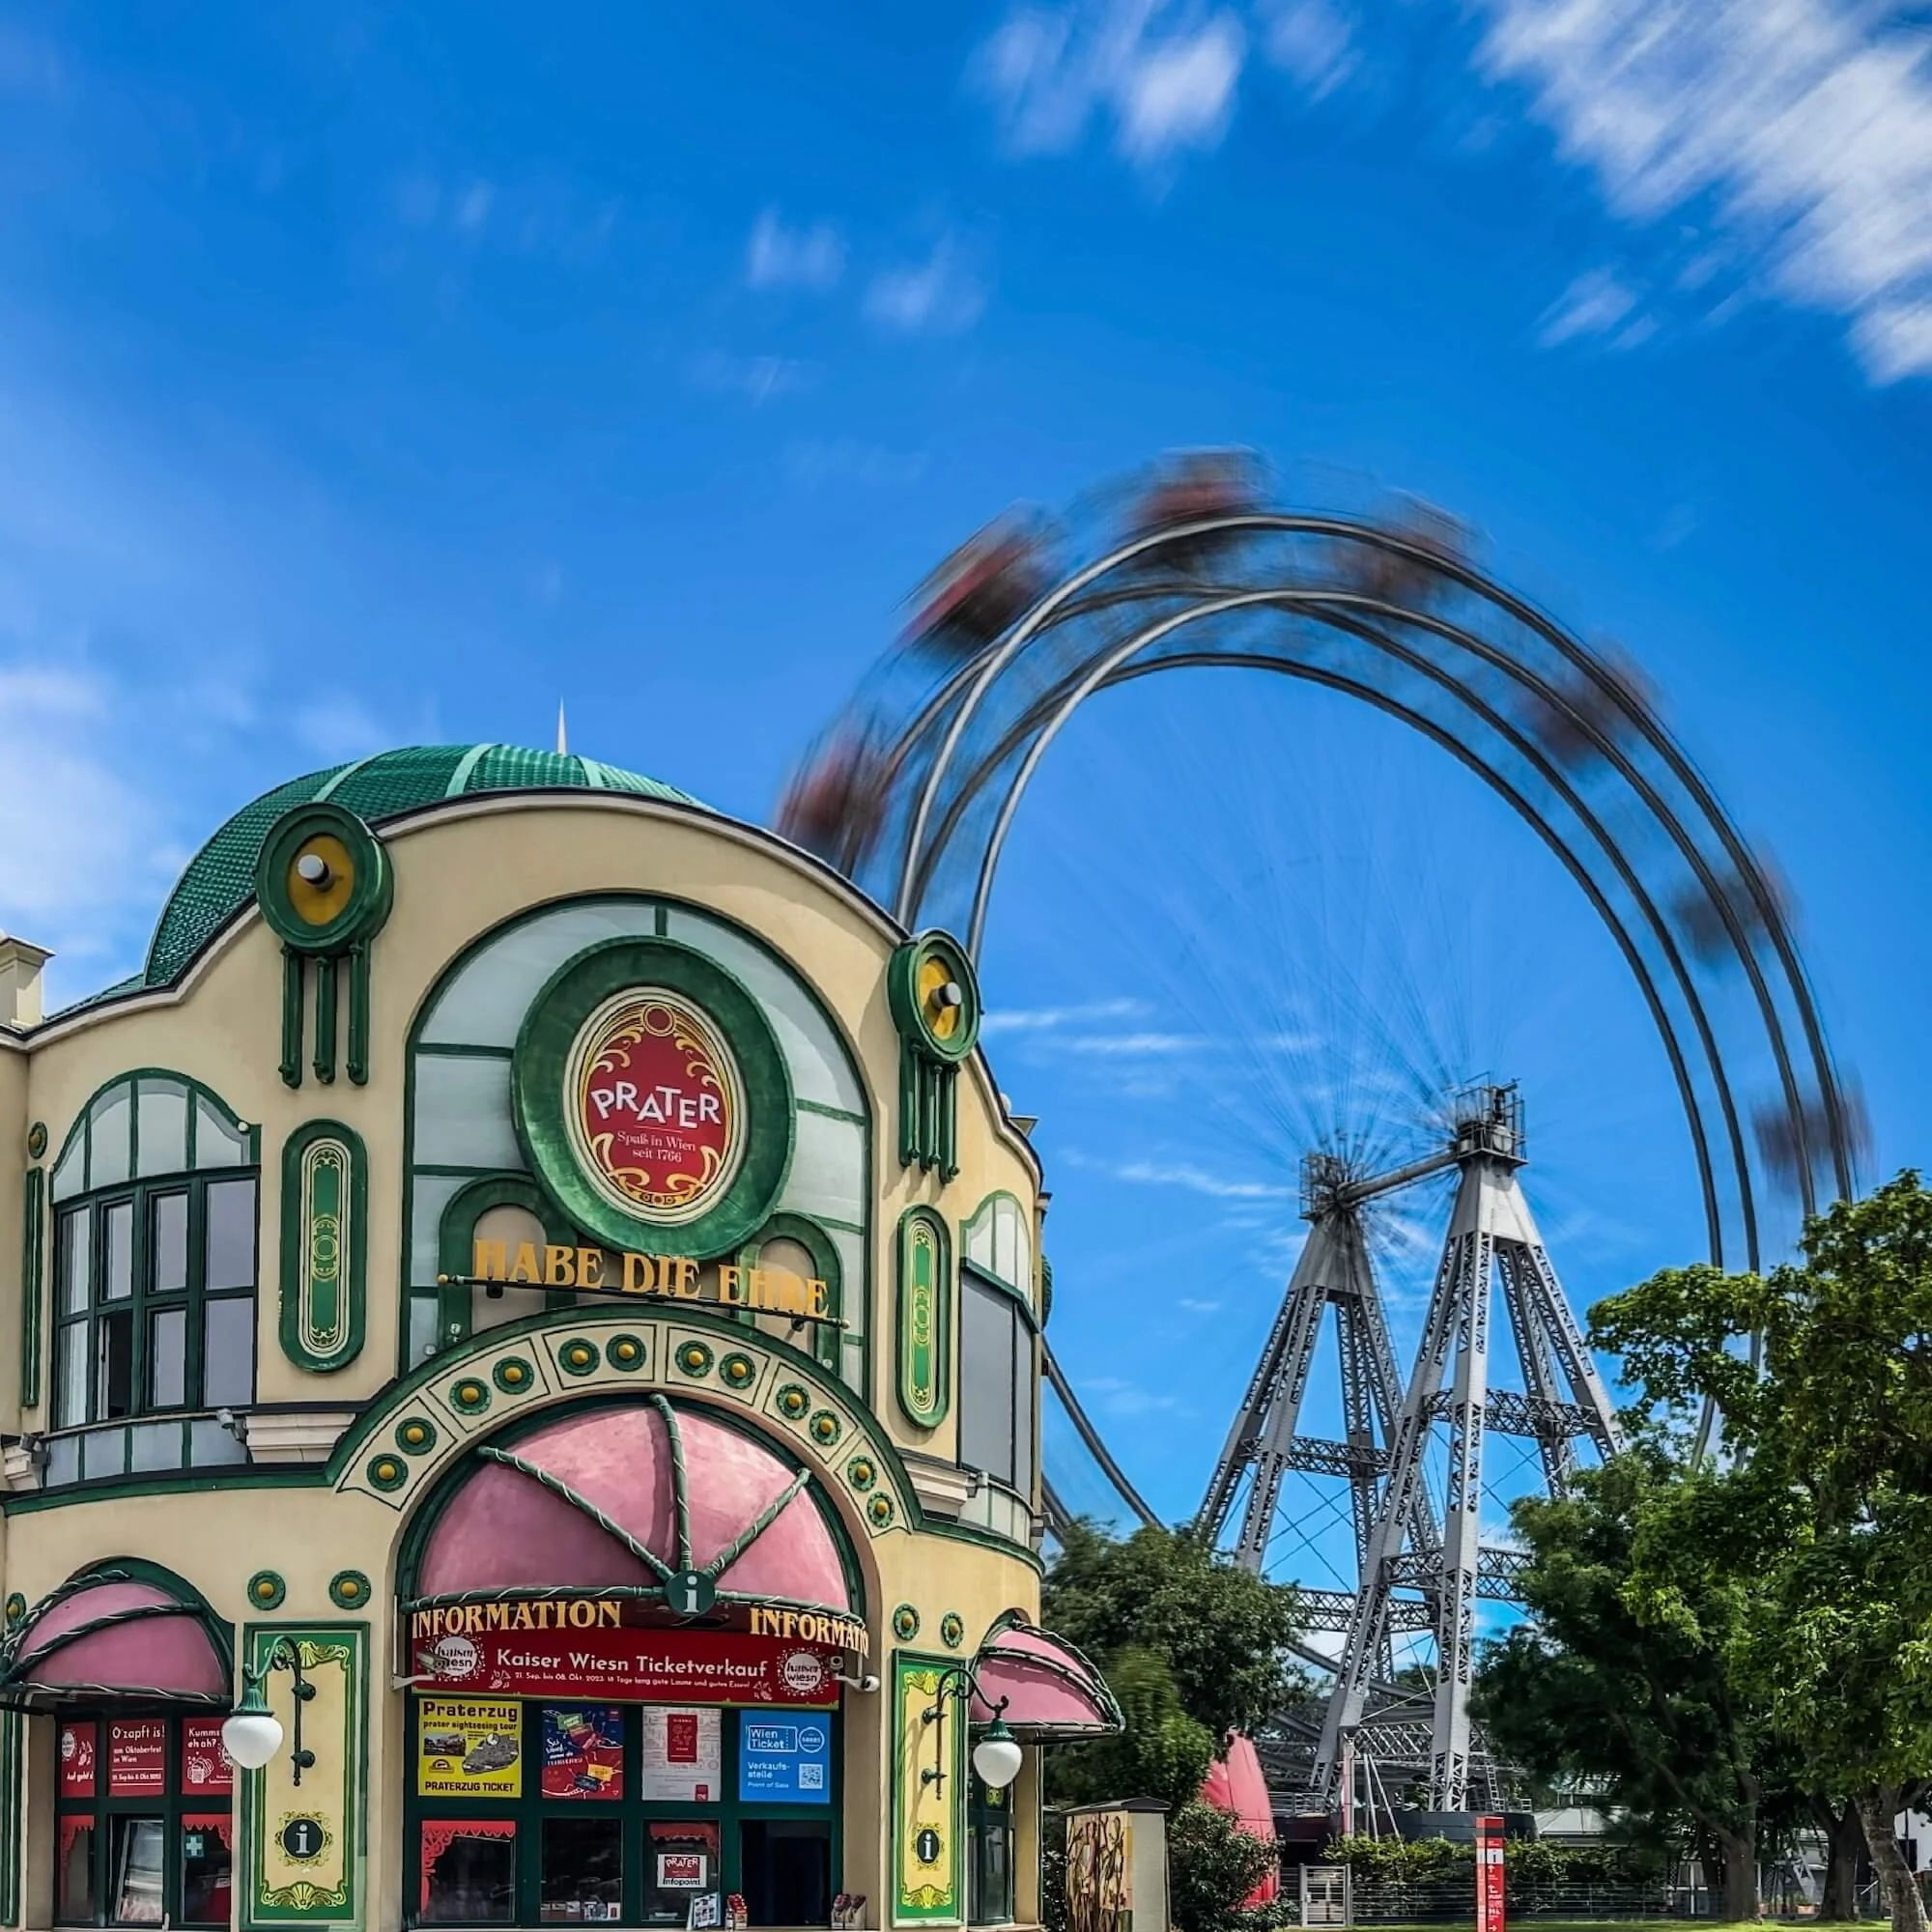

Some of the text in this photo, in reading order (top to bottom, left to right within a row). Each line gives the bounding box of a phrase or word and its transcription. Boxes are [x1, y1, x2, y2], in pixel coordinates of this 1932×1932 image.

[591, 1081, 721, 1128] PRATER
[617, 1130, 696, 1152] Spaß in Wien
[633, 1148, 682, 1163] seit 1766
[472, 1238, 606, 1290] HABE
[621, 1251, 701, 1299] DIE
[412, 1600, 622, 1639] INFORMATION
[497, 1648, 768, 1678] Kaiser Wiesn Ticketverkauf
[787, 1673, 817, 1682] wiesn
[423, 1700, 518, 1722] Praterzug
[423, 1720, 451, 1730] prater
[452, 1721, 498, 1732] sightseeing
[750, 1728, 779, 1739] Wien
[752, 1738, 785, 1750] Ticket
[747, 1761, 791, 1771] Verkaufs-
[424, 1780, 515, 1792] PRATERZUG TICKET
[666, 1857, 698, 1868] PRATER
[664, 1877, 700, 1887] Infopoint
